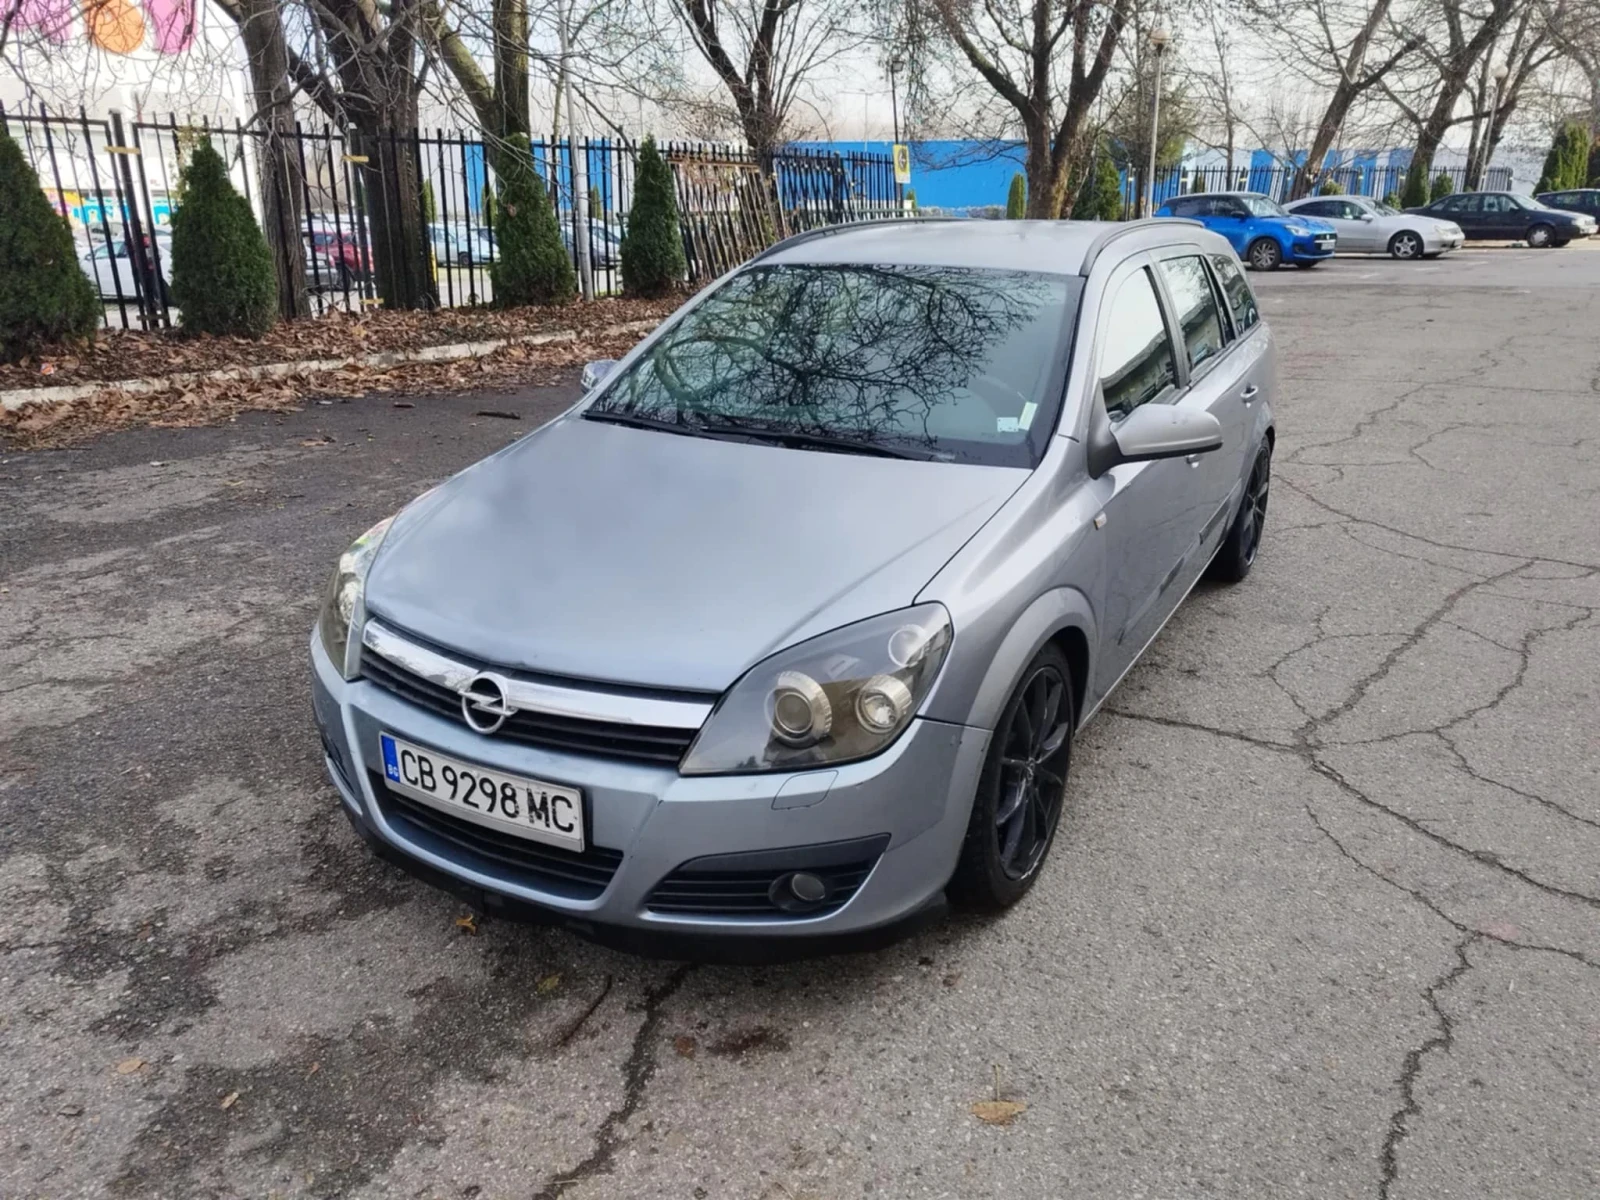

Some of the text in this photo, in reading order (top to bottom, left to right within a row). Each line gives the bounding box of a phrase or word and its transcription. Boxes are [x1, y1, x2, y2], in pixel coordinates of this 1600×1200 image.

[401, 750, 574, 833] CB 9298 MC
